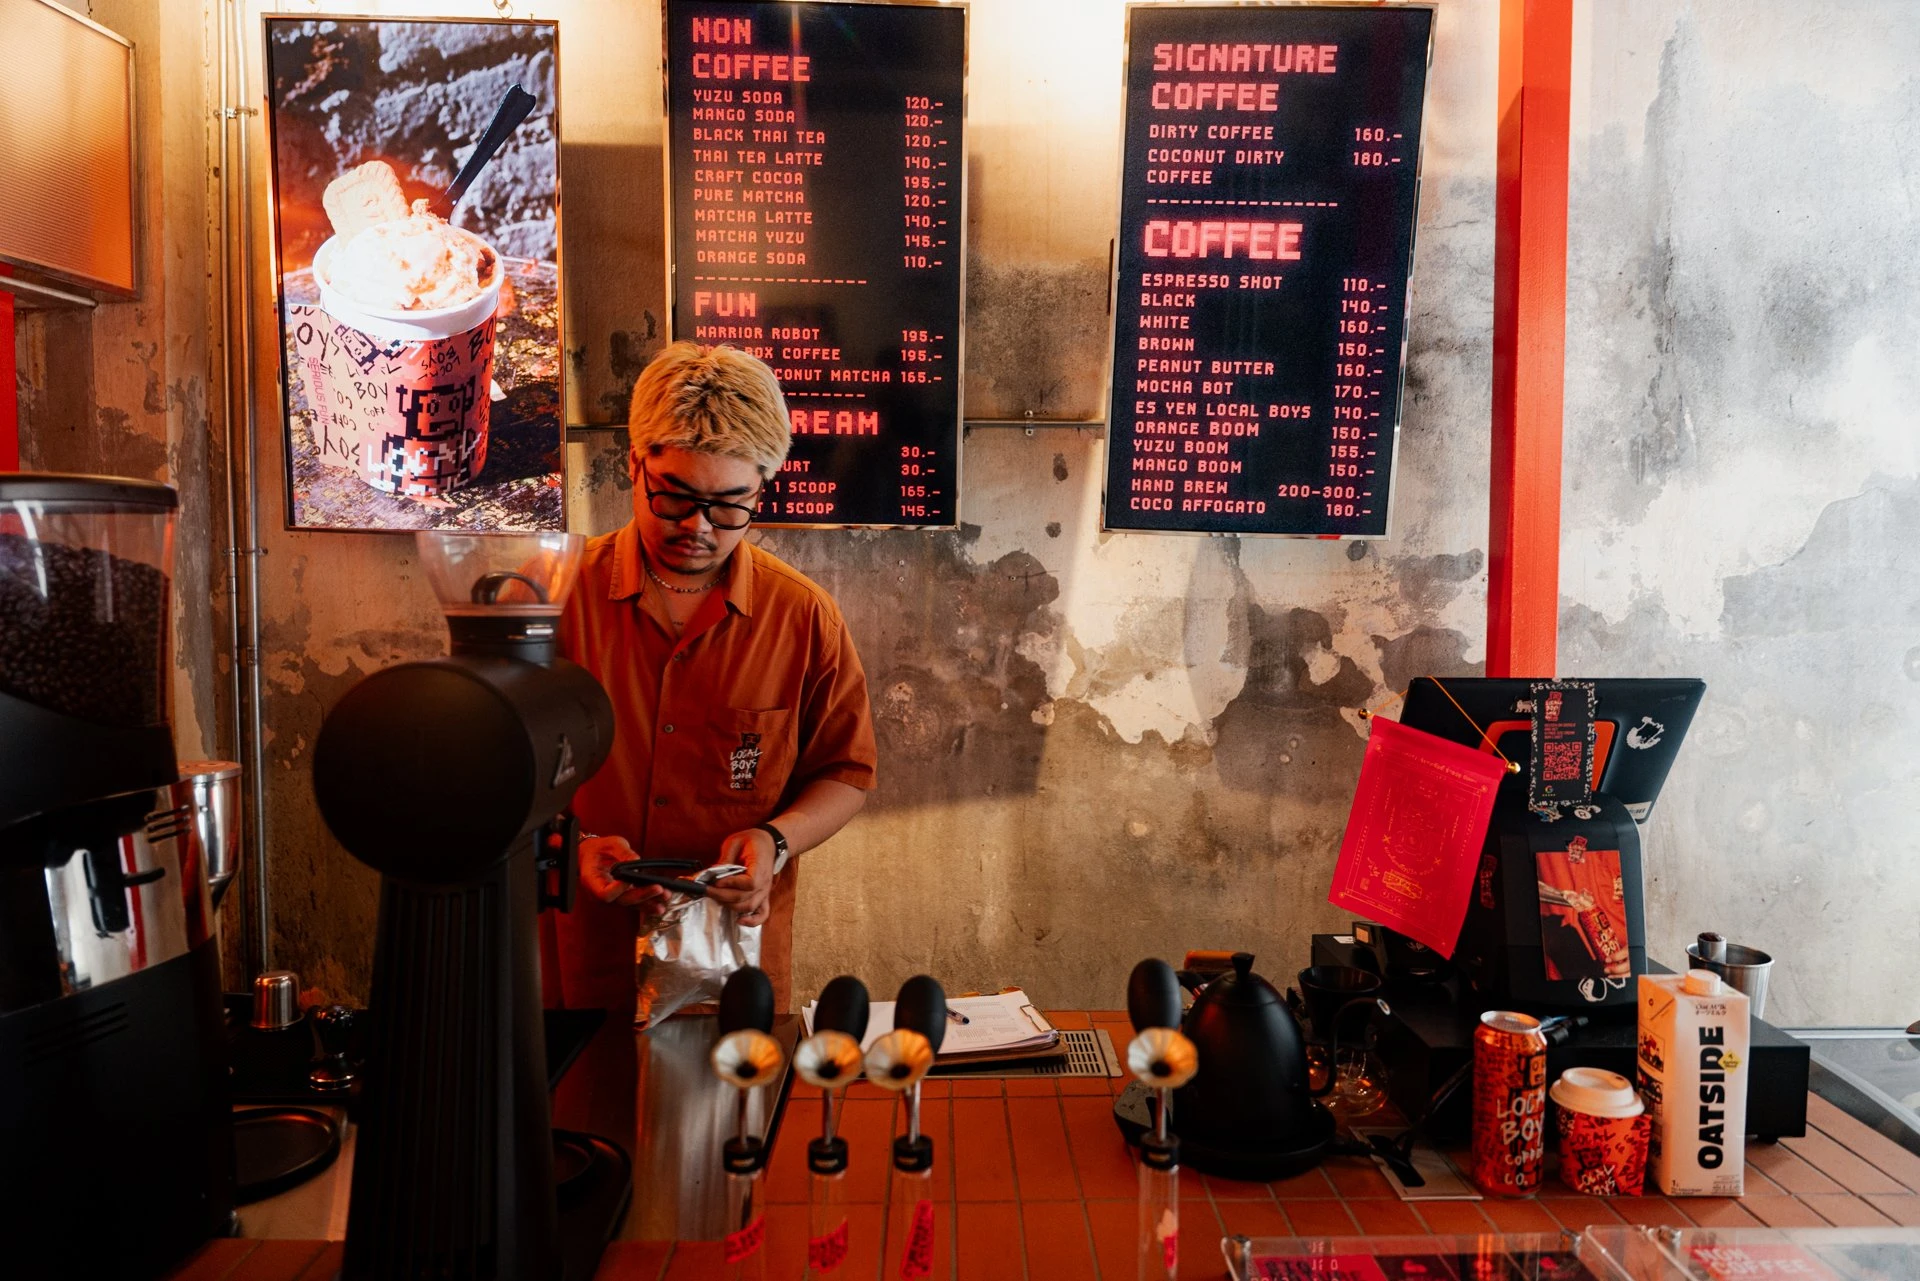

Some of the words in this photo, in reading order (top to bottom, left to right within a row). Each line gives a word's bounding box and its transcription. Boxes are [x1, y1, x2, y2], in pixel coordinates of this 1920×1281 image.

[693, 18, 751, 44] NON
[1154, 44, 1337, 72] SIGNATURE
[693, 54, 809, 81] COFFEE
[694, 90, 732, 102] YUZU
[743, 91, 782, 104] SODA
[906, 97, 943, 109] 120.-
[1152, 83, 1278, 111] COFFEE
[694, 108, 745, 121] MANGO
[756, 110, 794, 122] SODA
[906, 115, 942, 127] 120.-
[694, 128, 743, 141] BLACK
[753, 130, 787, 142] THAI
[797, 131, 824, 143] TEA
[905, 135, 947, 147] 120.-
[1150, 125, 1197, 138] DIRTY
[1208, 126, 1273, 139] COFFEE
[1356, 128, 1402, 141] 160.-
[694, 150, 727, 162] THAI
[737, 151, 765, 163] TEA
[776, 152, 822, 165] LATTE
[905, 157, 946, 169] 140.-
[1149, 149, 1225, 163] COCONUT
[1236, 151, 1284, 164] DIRTY
[1354, 152, 1400, 165] 180.-
[695, 170, 743, 182] CRAFT
[753, 172, 802, 184] COCOA
[905, 176, 945, 188] 195.-
[1147, 170, 1212, 184] COFFEE
[695, 189, 733, 201] PURE
[743, 190, 803, 203] MATCHA
[905, 195, 946, 207] 120.-
[696, 210, 756, 222] MATCHA
[766, 211, 812, 224] LATTE
[905, 215, 946, 227] 140.-
[697, 230, 756, 242] MATCHA
[766, 232, 804, 243] YUZU
[905, 235, 945, 247] 145.-
[1145, 221, 1302, 259] COFFEE
[698, 251, 756, 263] ORANGE
[767, 252, 805, 264] SODA
[904, 256, 942, 268] 110.-
[1142, 274, 1229, 288] ESPRESSO
[1240, 276, 1282, 289] SHOT
[1344, 279, 1385, 291] 110.-
[695, 292, 755, 317] FUN
[1142, 293, 1195, 306] BLACK
[1342, 300, 1387, 313] 140.-
[1140, 316, 1189, 328] WHITE
[1340, 320, 1385, 333] 160.-
[697, 326, 762, 338] WARRIOR
[772, 328, 819, 340] ROBOT
[903, 330, 943, 342] 195.-
[783, 348, 840, 360] COFFEE
[902, 350, 941, 361] 195.-
[1139, 338, 1194, 350] BROWN
[1339, 343, 1384, 356] 150.-
[775, 369, 822, 381] CONUT
[831, 370, 890, 382] MATCHA
[901, 372, 941, 383] 165.-
[1138, 359, 1201, 372] PEANUT
[1212, 361, 1273, 374] BUTTER
[1337, 364, 1382, 376] 160.-
[1137, 380, 1192, 393] MOCHA
[1203, 382, 1233, 394] BOT
[1335, 385, 1379, 398] 170.-
[1136, 401, 1155, 413] ES
[1166, 402, 1196, 415] YEN
[1207, 404, 1258, 417] LOCAL
[1270, 405, 1310, 418] BOYS
[1335, 407, 1379, 419] 140.-
[791, 410, 878, 435] REAM
[1136, 422, 1199, 434] ORANGE
[1210, 422, 1258, 436] BOOM
[1333, 427, 1377, 439] 150.-
[902, 446, 935, 457] 30.-
[1134, 440, 1174, 452] YUZU
[1185, 441, 1228, 454] BOOM
[1331, 446, 1375, 458] 155.-
[776, 460, 810, 472] URT
[902, 464, 935, 475] 30.-
[1133, 459, 1187, 471] MANGO
[1198, 460, 1241, 473] BOOM
[1330, 464, 1374, 476] 150.-
[775, 482, 779, 492] 1
[789, 482, 836, 493] SCOOP
[901, 486, 940, 497] 165.-
[1132, 479, 1173, 491] HAND
[1184, 481, 1227, 493] BREW
[1279, 485, 1371, 499] 200-300.-
[773, 502, 777, 513] 1
[787, 502, 833, 514] SCOOP
[901, 505, 940, 516] 145.-
[1131, 498, 1172, 510] COCO
[1183, 499, 1265, 513] AFFOGATO
[1327, 504, 1371, 516] 180.-
[730, 747, 763, 760] LOCAL
[730, 759, 757, 773] BOYS
[1497, 1090, 1546, 1119] LOCA
[1697, 1026, 1725, 1169] OATSIDE
[1501, 1113, 1545, 1146] BOY
[1710, 1260, 1814, 1275] COFFEE
